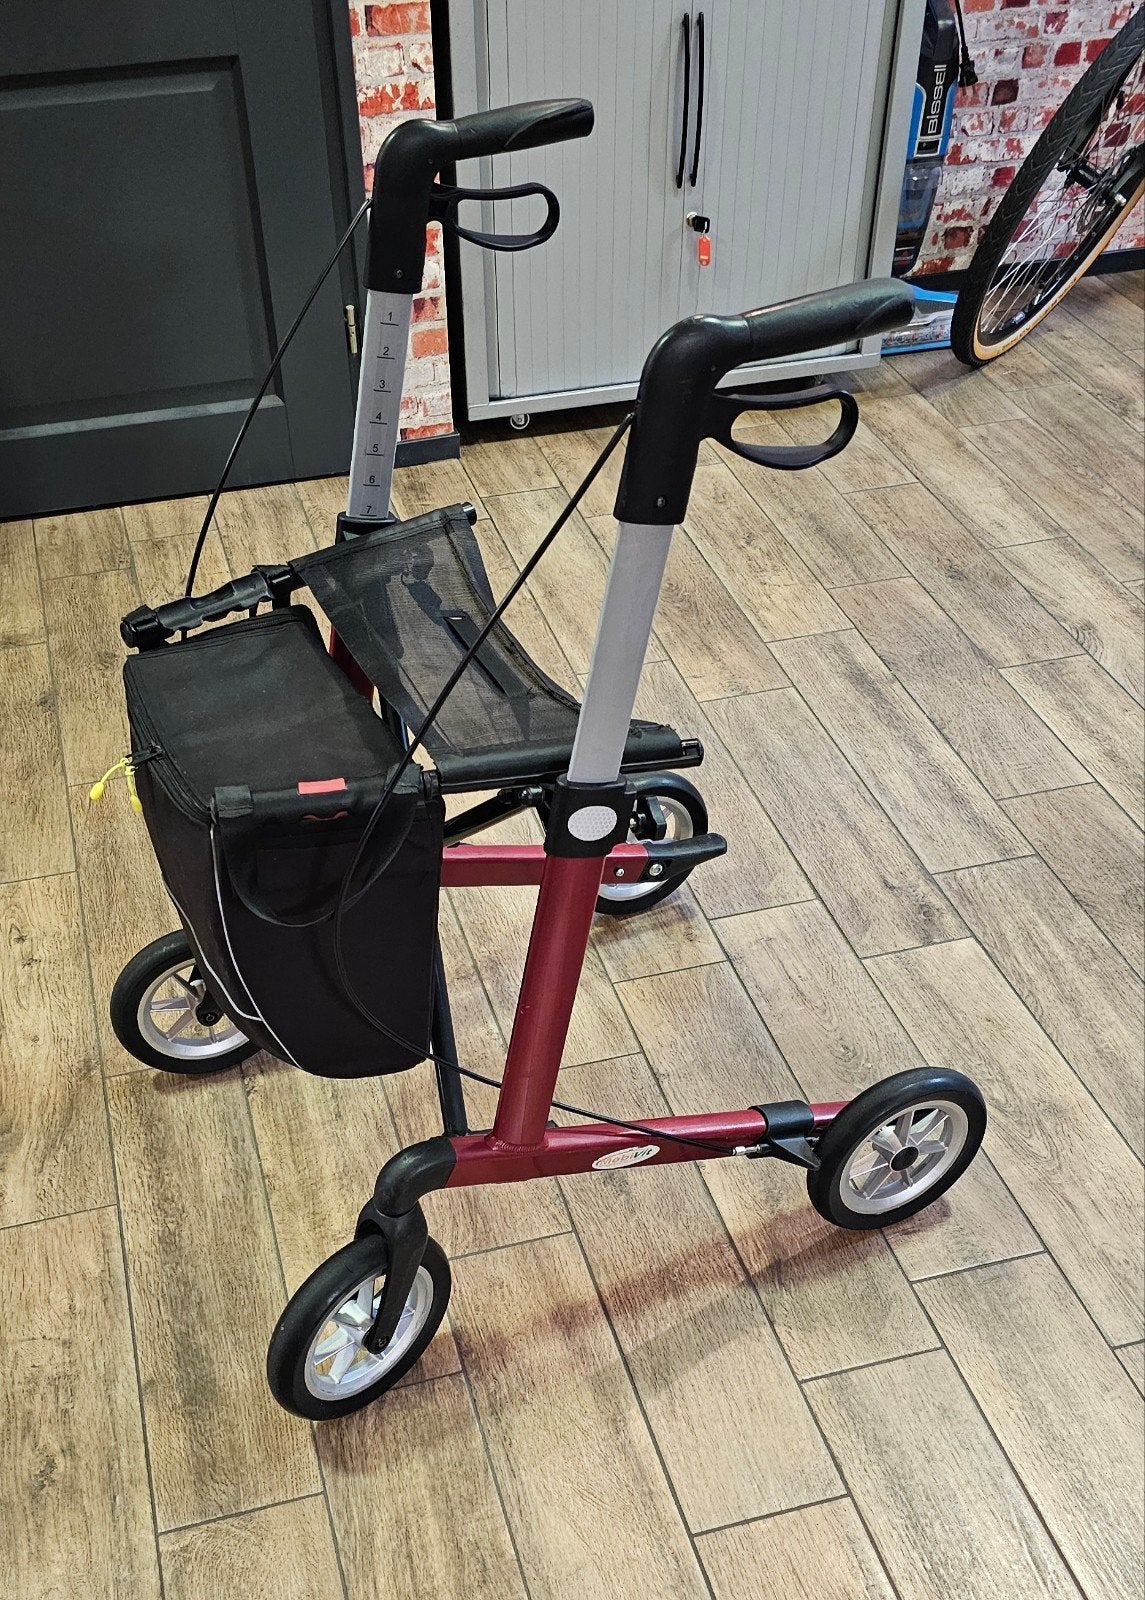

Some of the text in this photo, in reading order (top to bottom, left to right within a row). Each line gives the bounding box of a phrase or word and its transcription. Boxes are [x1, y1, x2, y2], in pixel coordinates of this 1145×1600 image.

[383, 347, 390, 356] 2
[378, 380, 386, 389] 3
[375, 412, 382, 421] 4
[372, 444, 379, 453] 5
[369, 475, 376, 484] 6
[365, 506, 372, 514] 7
